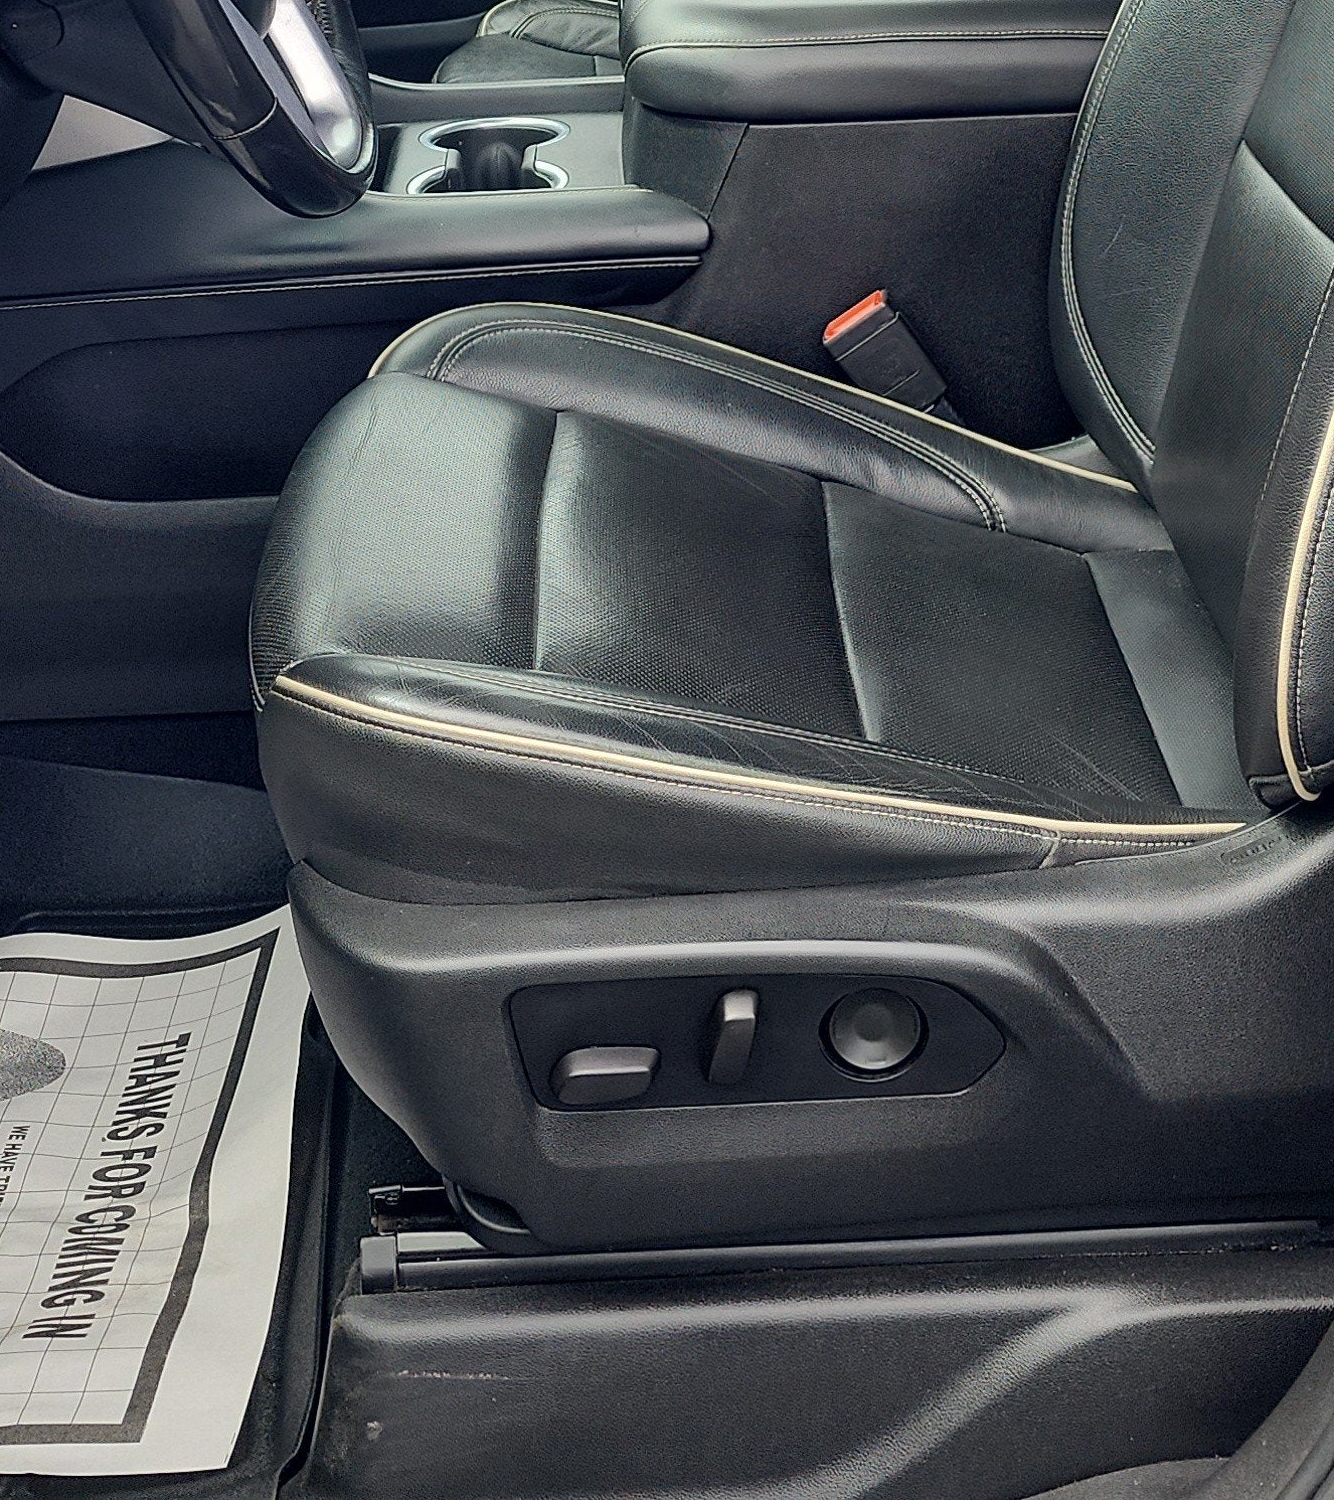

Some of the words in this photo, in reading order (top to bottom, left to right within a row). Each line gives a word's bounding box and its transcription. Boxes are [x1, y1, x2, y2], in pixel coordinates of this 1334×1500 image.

[107, 1032, 192, 1141] THANKS
[8, 1125, 30, 1141] WE
[83, 1145, 158, 1200] FOR
[41, 1204, 137, 1309] COMING
[22, 1313, 97, 1339] IN
